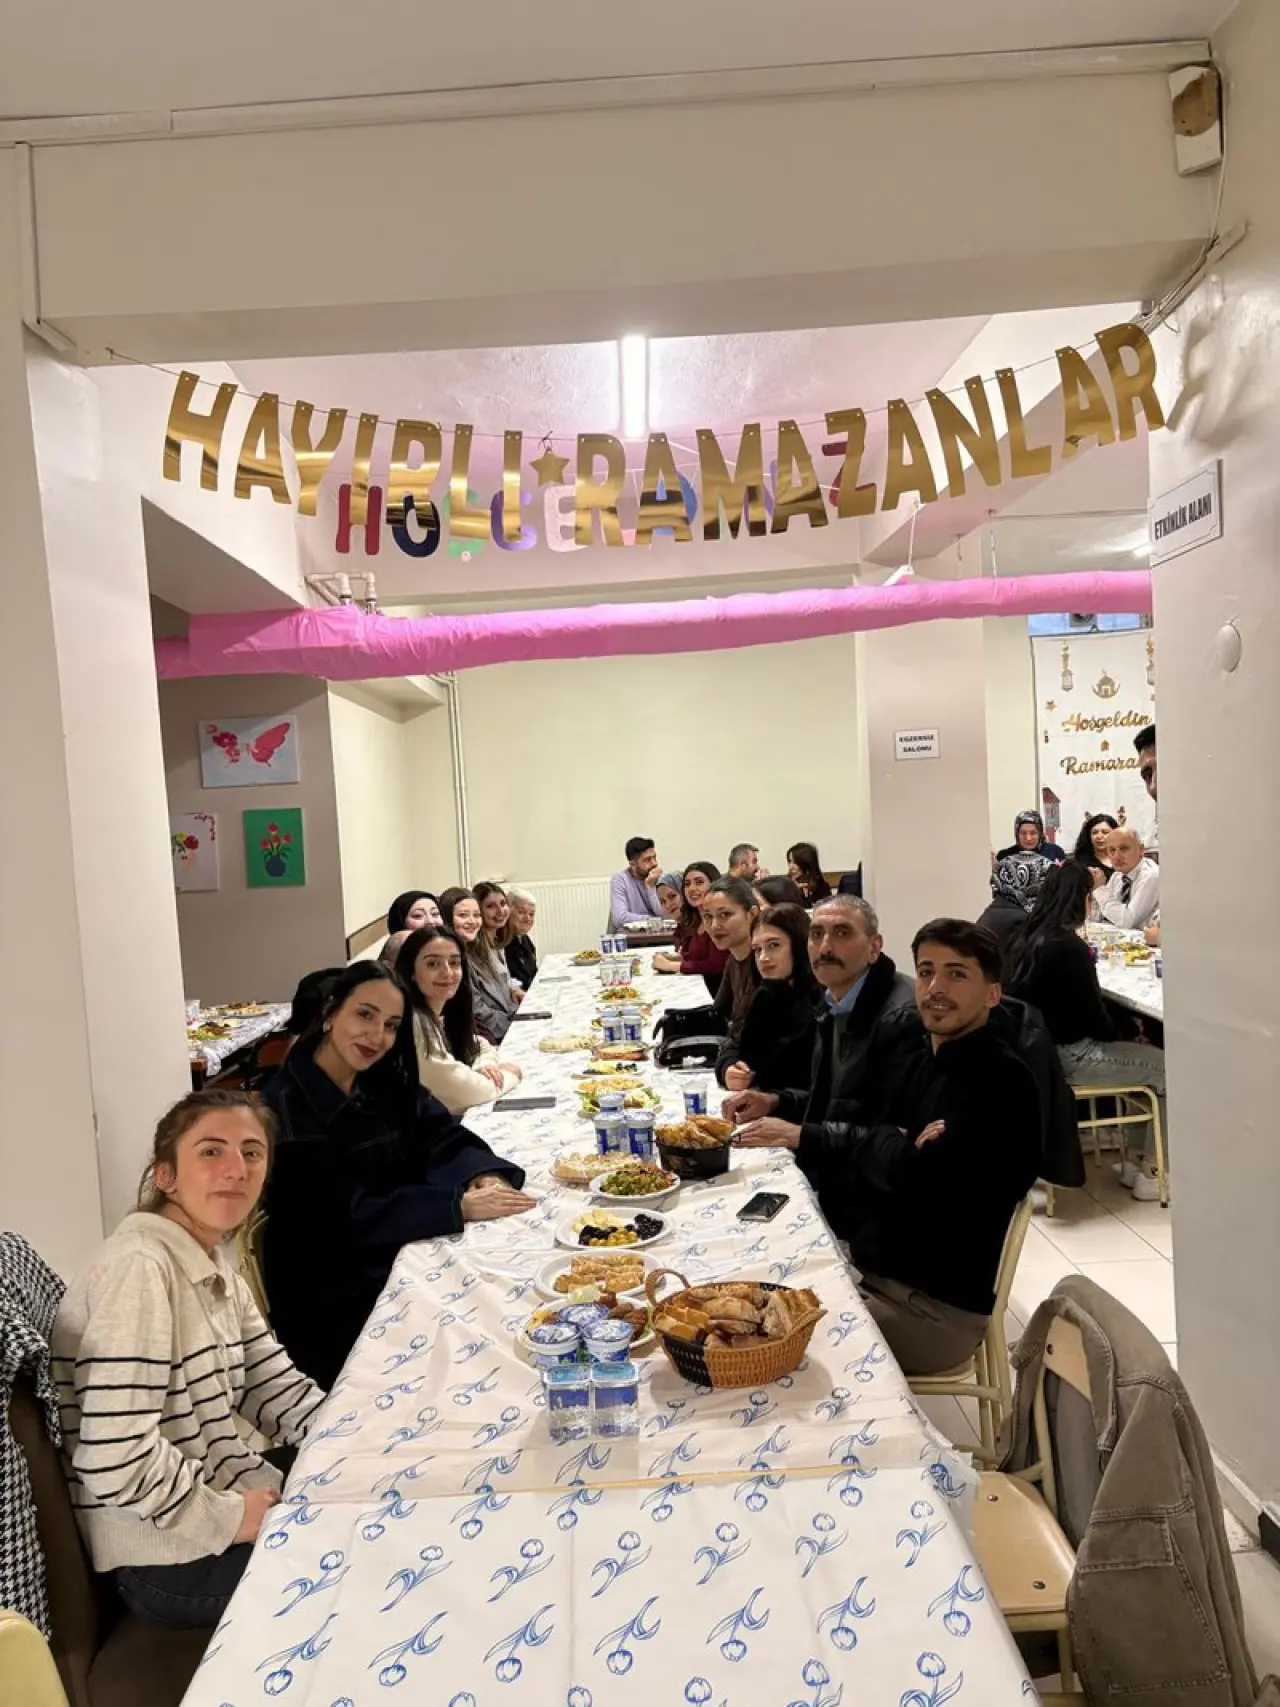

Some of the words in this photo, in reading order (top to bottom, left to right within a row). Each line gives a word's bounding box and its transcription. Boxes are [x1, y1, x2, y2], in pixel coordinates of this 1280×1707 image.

[163, 371, 523, 541] HAYIRLI
[575, 323, 1165, 546] RAMAZANLAR
[1155, 505, 1187, 540] ETKİNLİK
[1189, 493, 1211, 523] ALANI
[1060, 756, 1141, 775] Ramaza
